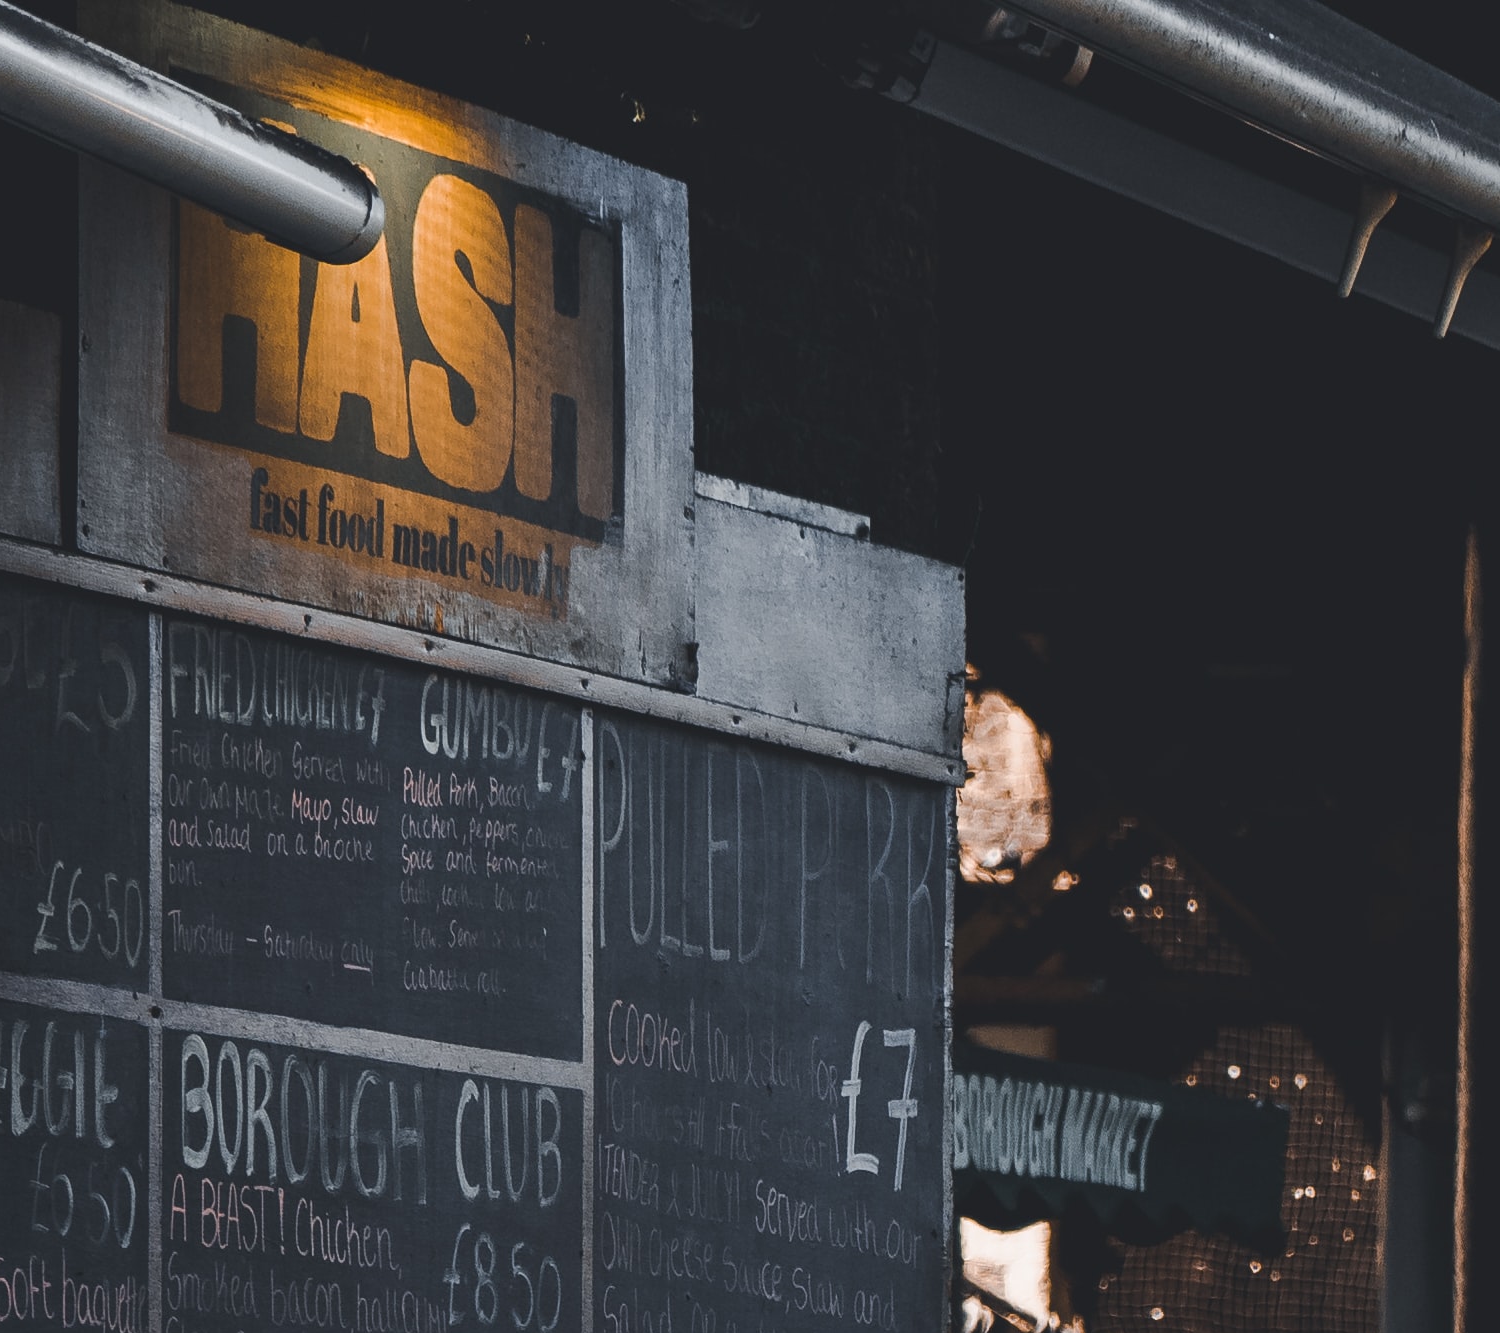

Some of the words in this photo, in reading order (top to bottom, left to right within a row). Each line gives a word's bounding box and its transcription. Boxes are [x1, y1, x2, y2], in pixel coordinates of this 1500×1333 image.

[179, 119, 613, 519] HASH
[250, 467, 311, 540] fast
[317, 483, 384, 559] food
[393, 515, 476, 578] made
[168, 622, 256, 726] FRIED
[168, 816, 201, 848] and
[267, 832, 288, 856] on
[296, 833, 308, 855] a
[403, 766, 443, 808] Pulled
[446, 847, 476, 875] and
[600, 719, 768, 964] PULLED
[181, 1034, 427, 1205] BOROUGH
[455, 1078, 562, 1207] CLUB
[840, 1019, 918, 1193] £7
[953, 1073, 1057, 1179] BOROUGH
[1058, 1086, 1164, 1192] MARKET
[169, 1173, 187, 1243] A
[200, 1177, 286, 1257] BEAST!
[167, 1250, 260, 1320] Smoked
[854, 1281, 899, 1333] and
